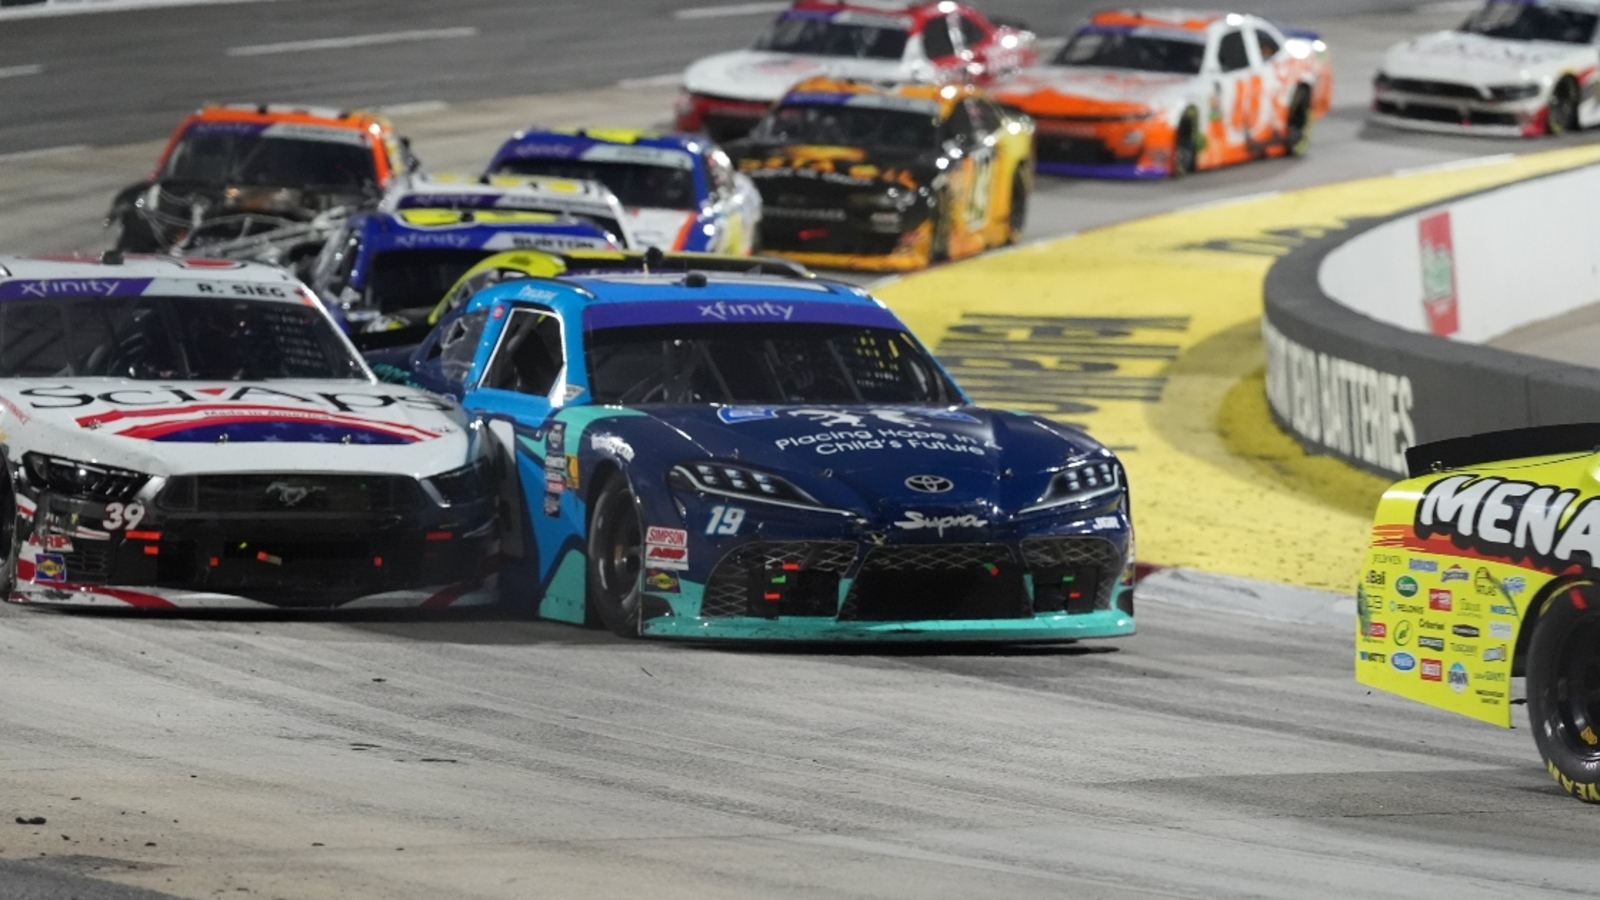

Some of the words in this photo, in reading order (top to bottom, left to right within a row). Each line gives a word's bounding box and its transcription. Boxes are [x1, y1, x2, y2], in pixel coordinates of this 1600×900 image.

[20, 279, 119, 297] xfinity
[197, 283, 223, 294] R.
[232, 285, 286, 298] SIEG
[697, 301, 794, 320] xfinity
[266, 410, 330, 420] America
[775, 430, 873, 450] Placing
[878, 429, 947, 440] Hope
[815, 439, 902, 455] Child's
[908, 439, 985, 455] Future
[102, 502, 145, 530] 39
[704, 505, 746, 535] 19
[894, 511, 988, 538] Supra
[648, 528, 685, 545] SIMPSON
[1476, 585, 1496, 596] ATLAS
